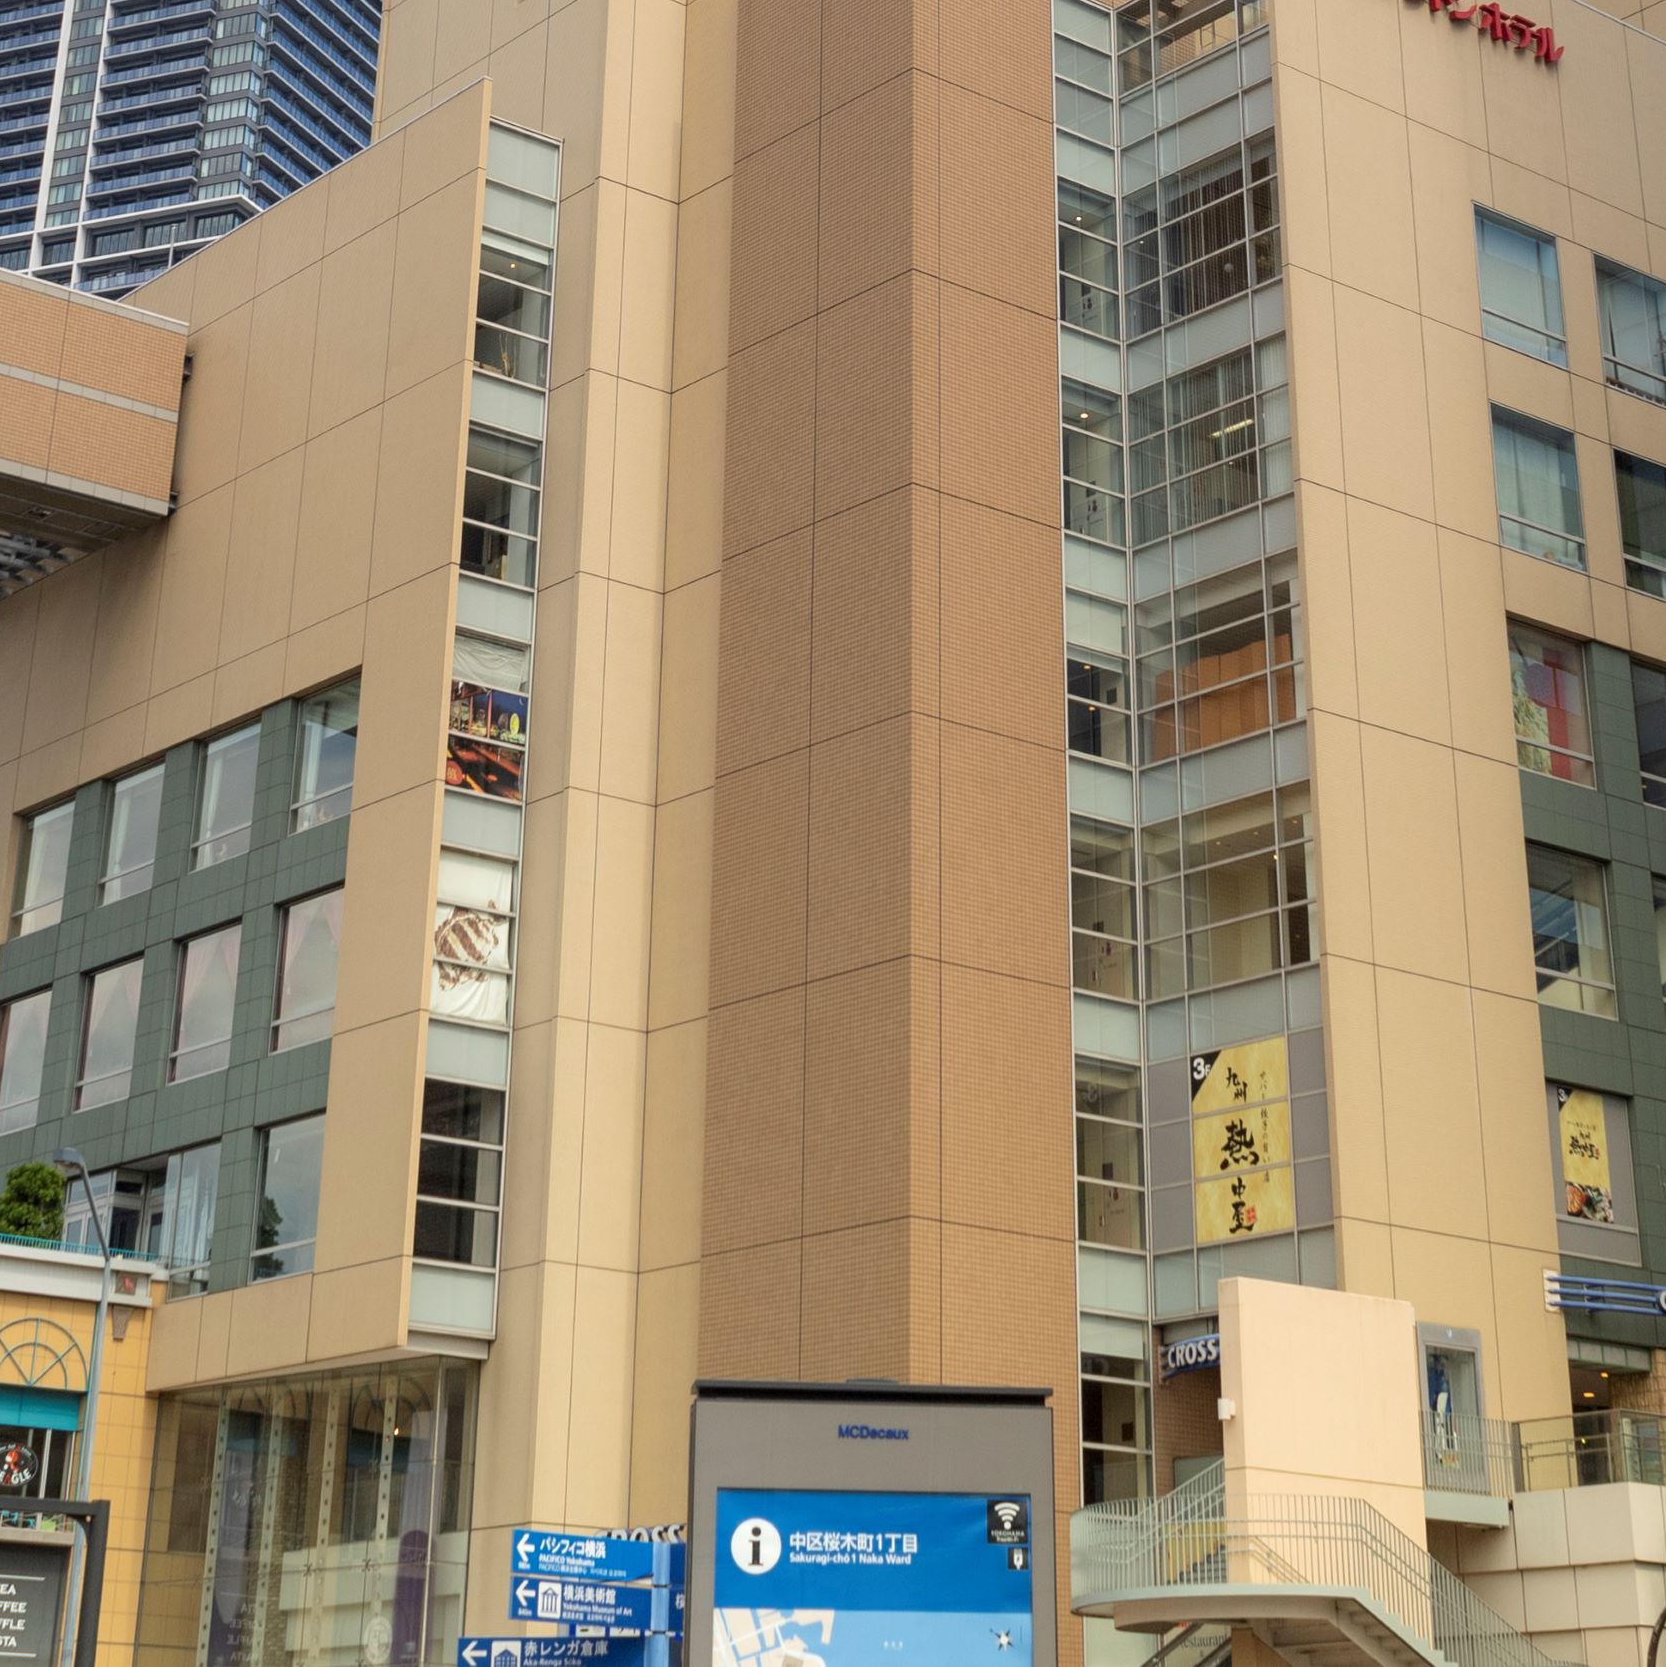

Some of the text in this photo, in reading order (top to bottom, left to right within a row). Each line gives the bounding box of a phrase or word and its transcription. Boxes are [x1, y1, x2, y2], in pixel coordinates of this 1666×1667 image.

[1168, 1339, 1217, 1368] CROSS
[838, 1425, 909, 1440] MCDecaux
[540, 1536, 606, 1559] パシフィコ横浜
[789, 1532, 918, 1554] 中区桜木町1丁目
[859, 1553, 884, 1565] Naka
[885, 1553, 912, 1565] Ward
[563, 1584, 616, 1606] 横浜美術館
[524, 1640, 609, 1657] 赤レンガ倉庫
